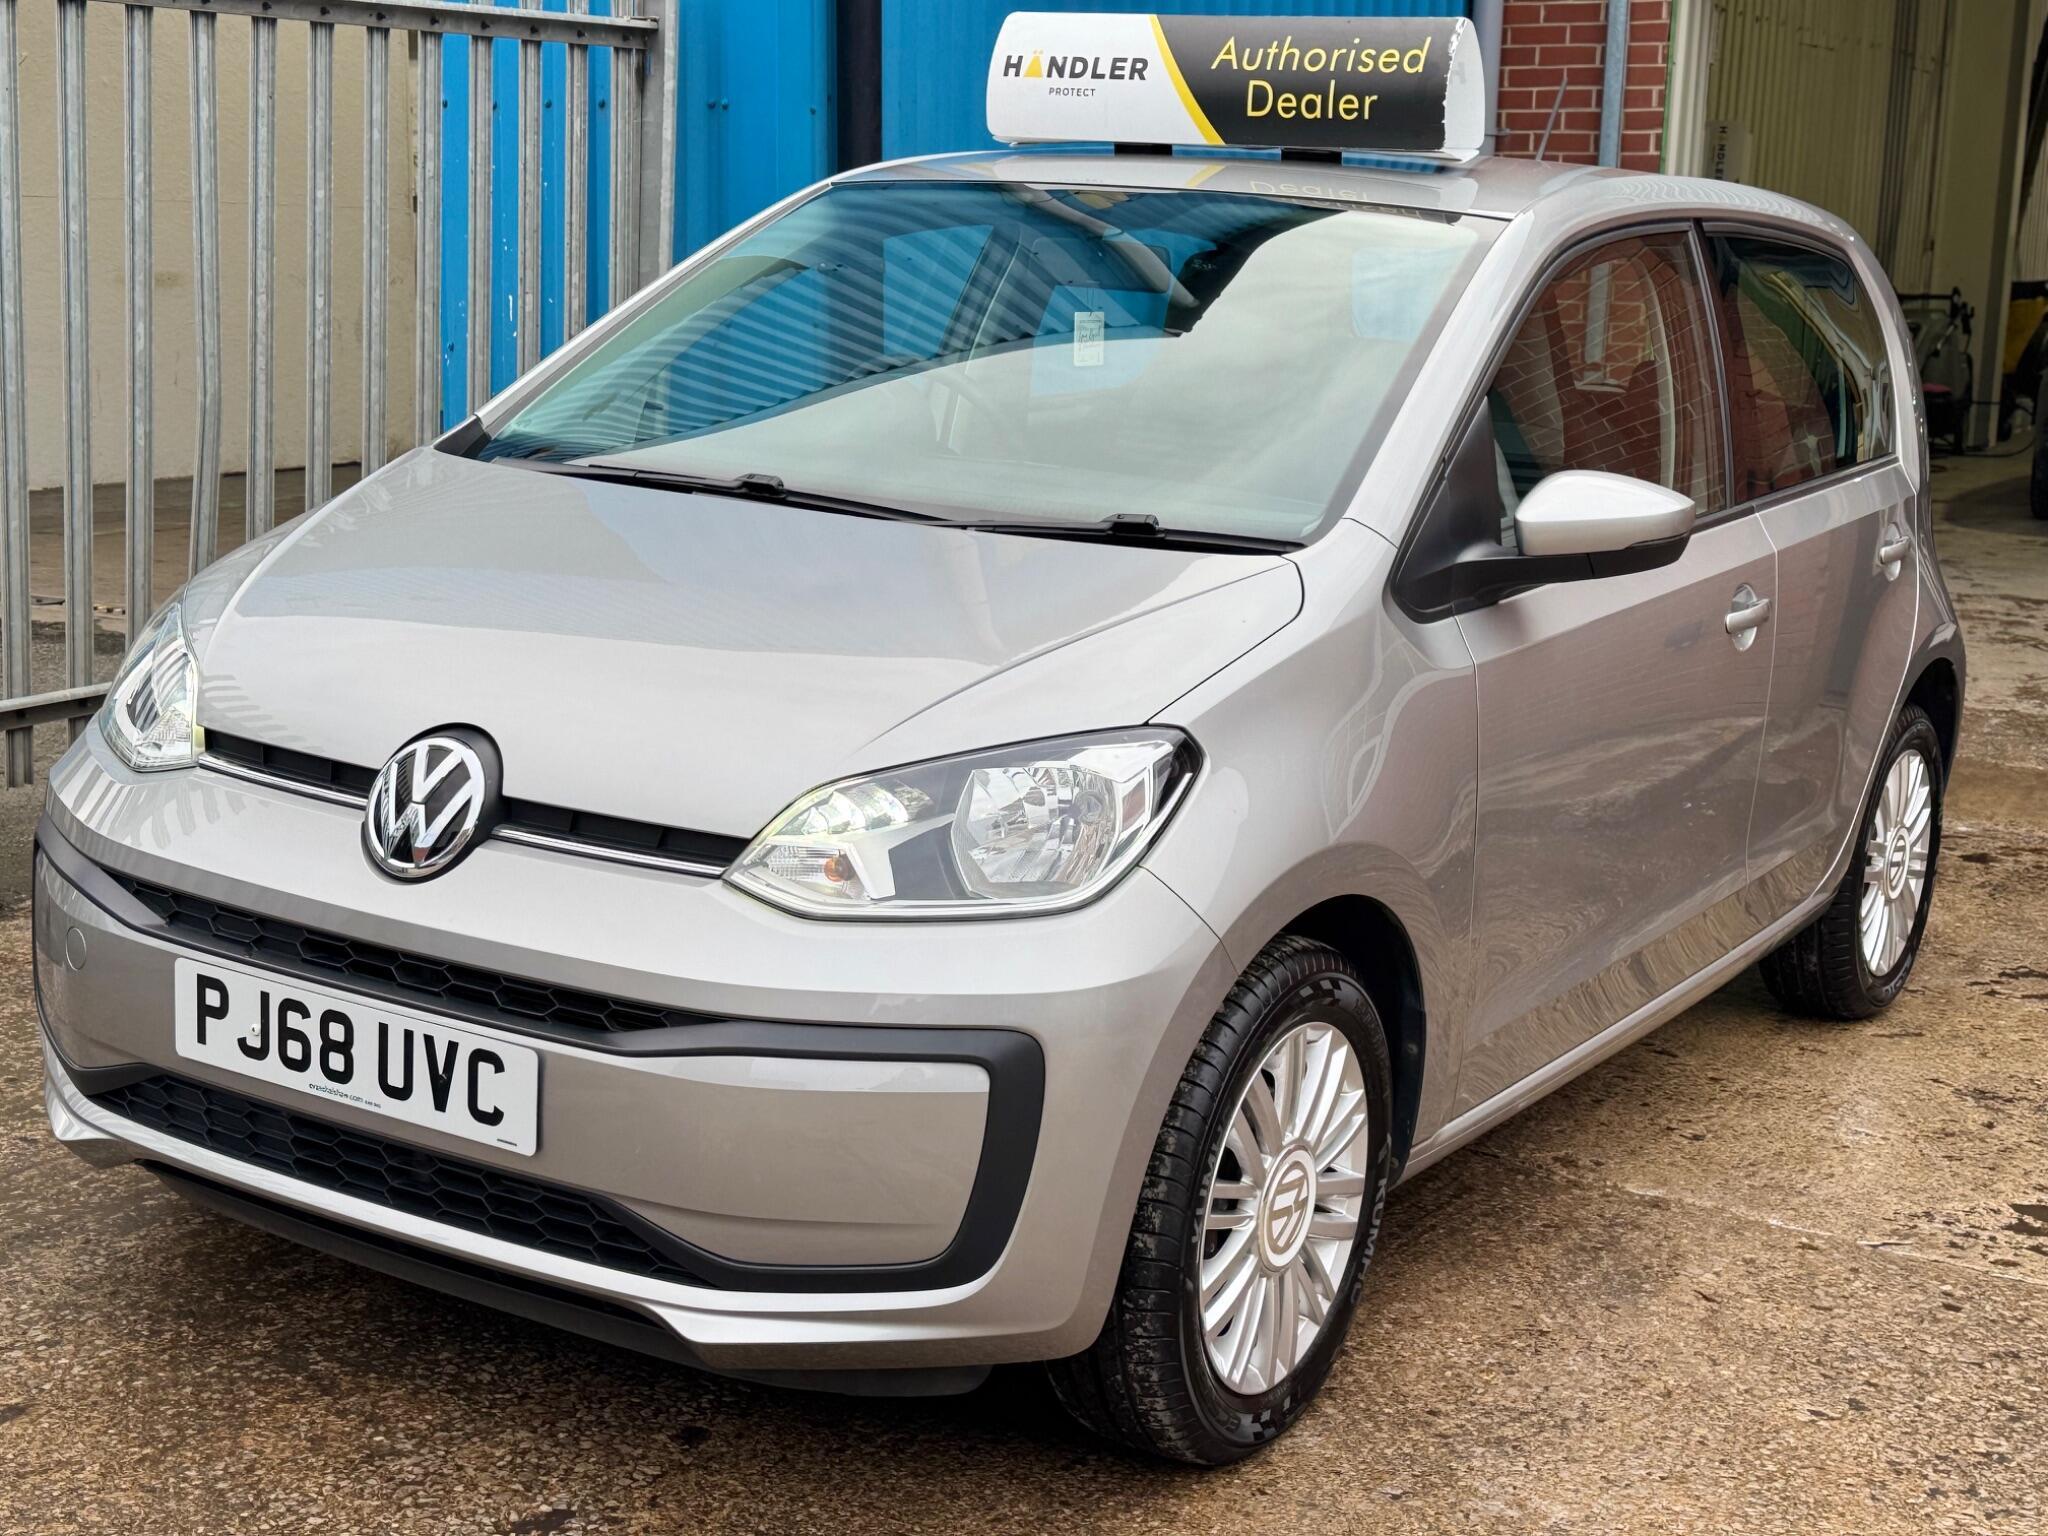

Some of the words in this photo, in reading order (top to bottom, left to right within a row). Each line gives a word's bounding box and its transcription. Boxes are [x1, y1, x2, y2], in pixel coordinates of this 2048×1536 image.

[1002, 50, 1149, 80] HÄNDLER
[1211, 36, 1431, 74] Authorised
[1048, 87, 1096, 97] PROTECT
[1246, 79, 1379, 120] Dealer
[368, 737, 486, 876] VW
[196, 973, 355, 1085] PJ68
[377, 1022, 506, 1127] UVC
